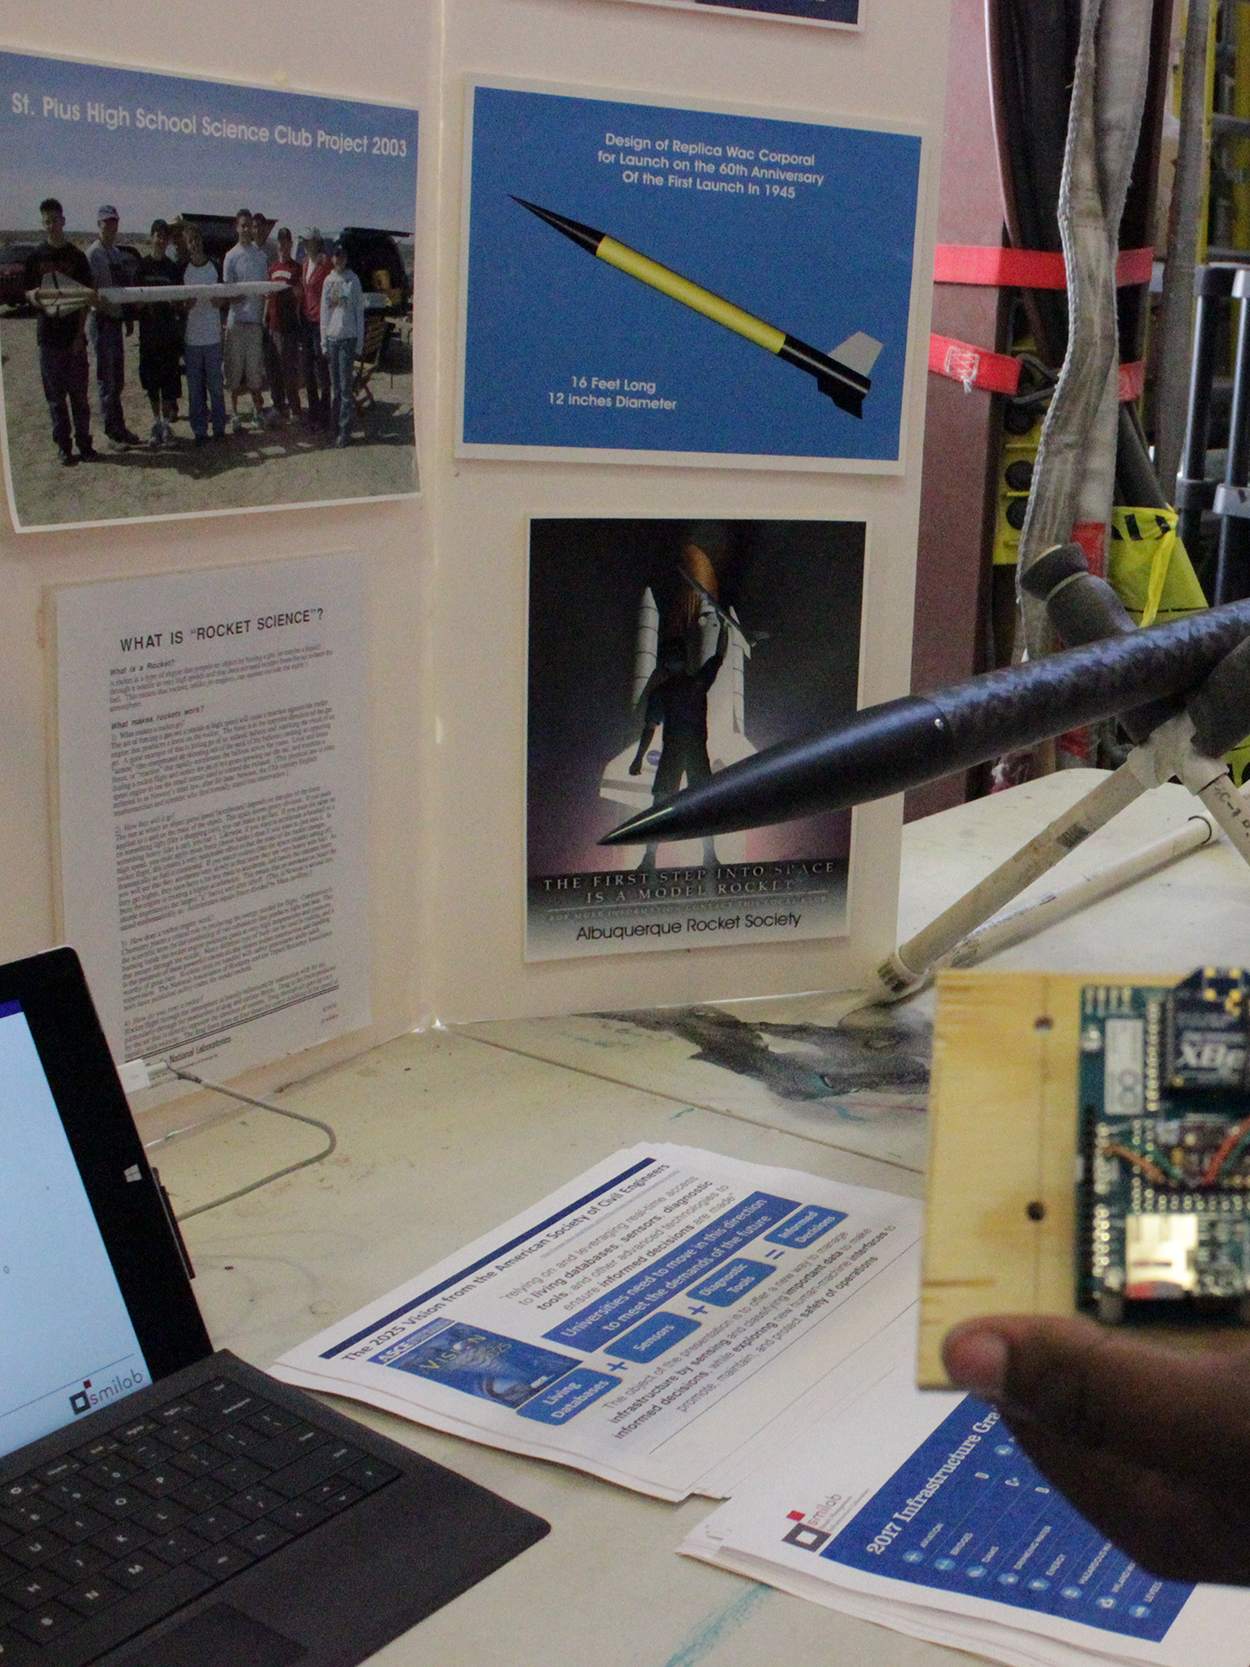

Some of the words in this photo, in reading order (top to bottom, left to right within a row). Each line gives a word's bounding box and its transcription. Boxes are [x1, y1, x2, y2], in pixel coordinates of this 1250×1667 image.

[12, 92, 35, 115] St.
[43, 96, 80, 121] Pius
[87, 101, 130, 130] High
[136, 108, 196, 134] School
[202, 116, 269, 142] Science
[274, 125, 312, 147] Club
[317, 130, 368, 154] Project
[372, 137, 407, 157] 2003
[605, 132, 651, 151] Design
[655, 139, 669, 150] of
[672, 140, 722, 156] Replica
[726, 146, 754, 159] Wac
[758, 149, 815, 166] Corporal
[598, 151, 615, 163] for
[619, 153, 669, 168] Launch
[673, 160, 690, 170] on
[694, 160, 715, 173] the
[719, 163, 748, 177] 60th
[751, 166, 824, 186] Anniversary
[622, 170, 638, 183] Of
[642, 172, 663, 185] the
[668, 175, 693, 188] First
[696, 179, 744, 193] Launch
[748, 183, 760, 195] In
[765, 184, 795, 198] 1945
[549, 392, 564, 404] 12
[569, 394, 612, 406] inches
[616, 395, 677, 410] Diameter
[572, 376, 587, 388] 16
[592, 377, 619, 390] Feet
[624, 379, 656, 394] Long
[120, 633, 163, 652] WHAT
[170, 631, 183, 645] IS
[544, 878, 581, 891] THE
[593, 873, 649, 887] FIRST
[659, 870, 706, 883] STEP
[717, 866, 764, 879] INTO
[775, 862, 834, 875] SPACE
[587, 892, 603, 903] IS
[616, 891, 626, 900] A
[639, 885, 706, 899] MODEL
[576, 922, 682, 941] Albuquerque
[687, 915, 740, 932] Rocket
[745, 912, 801, 928] Society
[540, 1268, 555, 1276] on
[555, 1254, 577, 1268] and
[574, 1222, 629, 1254] leveraging
[625, 1196, 666, 1222] real-time
[665, 1176, 698, 1196] access
[570, 1276, 592, 1290] and
[590, 1259, 616, 1276] other
[617, 1228, 664, 1259] advanced
[661, 1192, 718, 1229] technologies
[778, 1211, 817, 1238] Informed
[795, 1216, 834, 1242] Decisions
[518, 1297, 533, 1305] to
[530, 1278, 567, 1297] living
[663, 1181, 712, 1213] diagnostic
[341, 1346, 372, 1360] The
[369, 1326, 405, 1345] 2025
[402, 1302, 445, 1324] Vision
[441, 1284, 475, 1301] from
[472, 1271, 497, 1283] the
[495, 1239, 549, 1271] American
[546, 1215, 589, 1238] Society
[586, 1205, 600, 1214] of
[597, 1192, 623, 1206] Civil
[619, 1164, 669, 1193] Engineers
[561, 1295, 628, 1336] Universities
[626, 1275, 656, 1295] need
[651, 1268, 668, 1276] to
[666, 1249, 696, 1268] move
[691, 1241, 708, 1249] in
[703, 1228, 726, 1241] this
[723, 1199, 766, 1228] direction
[563, 1287, 600, 1310] ensure
[599, 1256, 647, 1286] informed
[646, 1224, 694, 1256] decisions
[692, 1213, 710, 1224] are
[602, 1321, 620, 1330] to
[617, 1301, 649, 1321] meet
[644, 1288, 667, 1301] the
[665, 1257, 713, 1288] demands
[710, 1247, 724, 1257] of
[720, 1236, 742, 1248] the
[736, 1215, 771, 1236] future
[699, 1264, 747, 1295] Diagnostic
[726, 1276, 754, 1292] Tools
[799, 1297, 828, 1317] safety
[825, 1288, 836, 1297] of
[835, 1256, 877, 1289] operations
[611, 1376, 678, 1422] infrastructure
[675, 1365, 693, 1375] by
[690, 1339, 731, 1365] sensing
[726, 1326, 746, 1338] and
[784, 1264, 826, 1294] important
[823, 1251, 843, 1264] data
[615, 1404, 662, 1438] informed
[732, 1322, 778, 1351] exploring
[849, 1232, 887, 1260] interfaces
[633, 1325, 674, 1350] Sensors
[377, 1342, 413, 1363] ASCE
[89, 1368, 143, 1405] smilab
[542, 1382, 581, 1404] Living
[551, 1381, 608, 1417] Databases
[866, 1522, 901, 1553] 2017
[893, 1435, 980, 1521] Infrastructure
[1045, 1554, 1064, 1575] ENERGY
